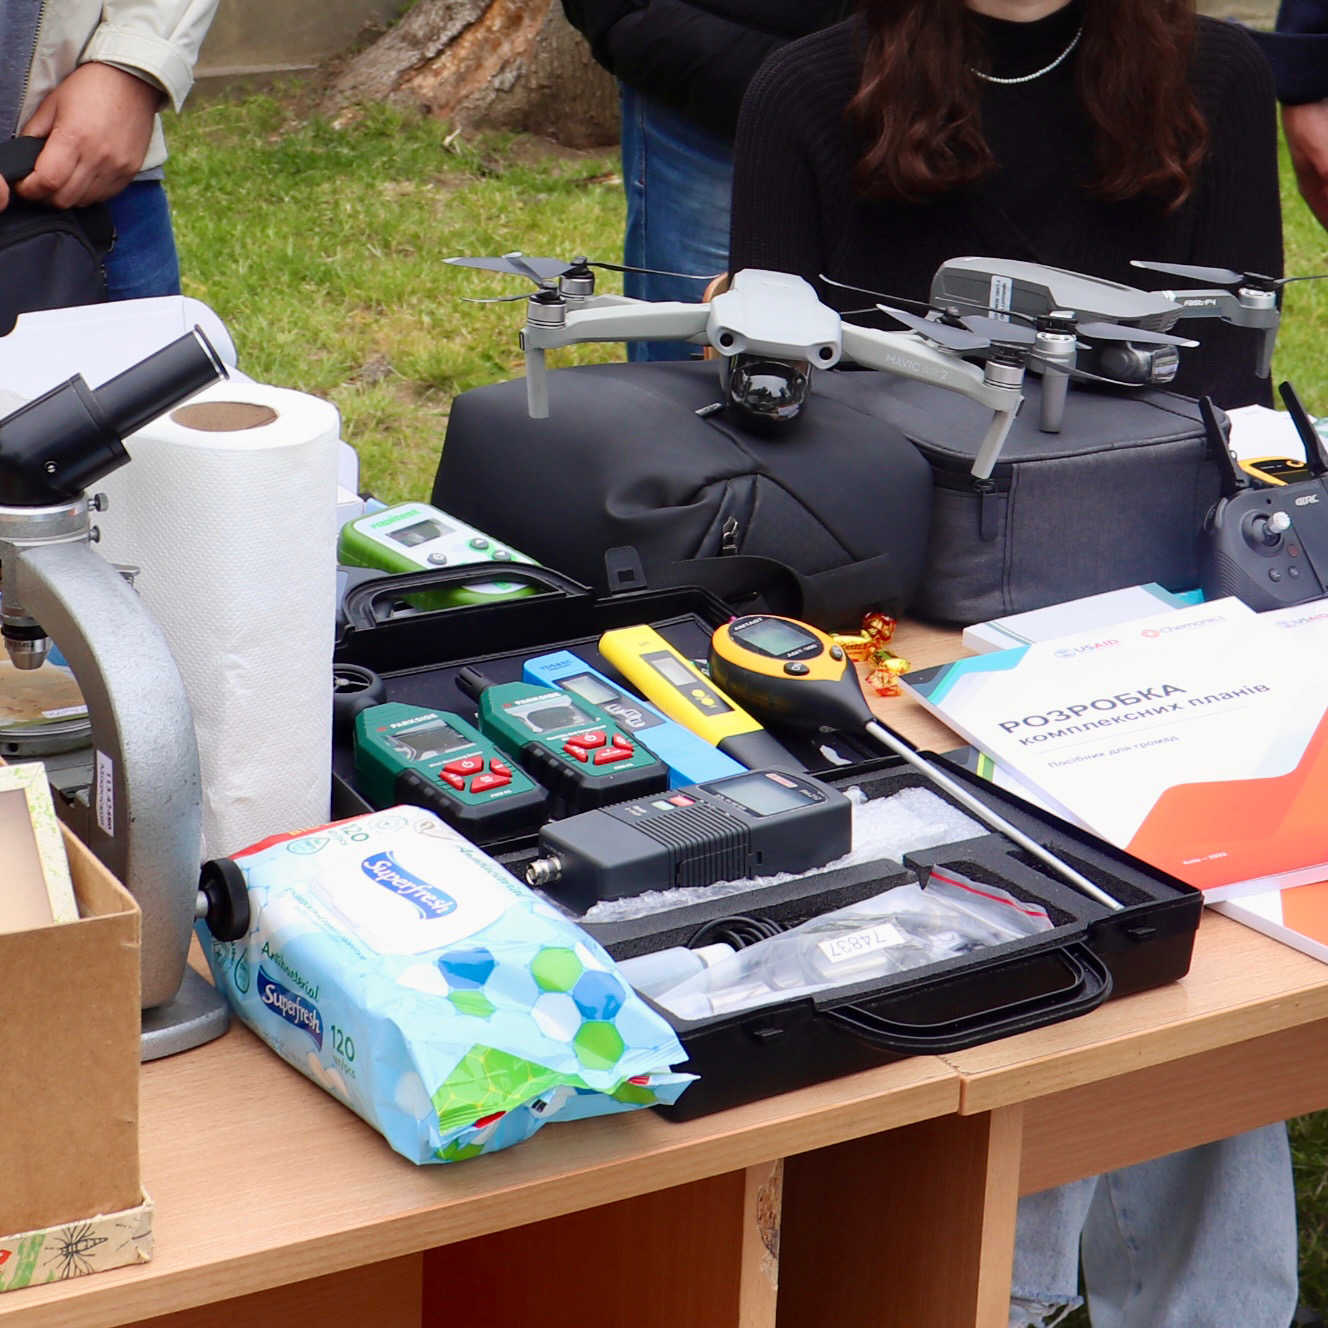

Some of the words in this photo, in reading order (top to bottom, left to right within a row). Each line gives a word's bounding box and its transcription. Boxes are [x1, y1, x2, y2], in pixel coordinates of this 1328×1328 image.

[885, 354, 921, 372] MAVIC
[940, 370, 948, 380] 2
[1074, 638, 1120, 655] USAID
[514, 691, 562, 707] PARKSIDE
[998, 683, 1189, 735] РОЗРОБКА
[1018, 700, 1184, 747] комплексних
[1187, 683, 1272, 708] планів
[390, 712, 439, 729] PARKSIDE
[1047, 750, 1105, 769] Посібник
[1108, 744, 1132, 757] для
[1133, 734, 1181, 752] громад
[340, 823, 370, 843] 120
[363, 858, 456, 917] Superfresh
[828, 926, 887, 958] 74837
[261, 983, 322, 1035] Superfresh
[330, 1024, 356, 1063] 120
